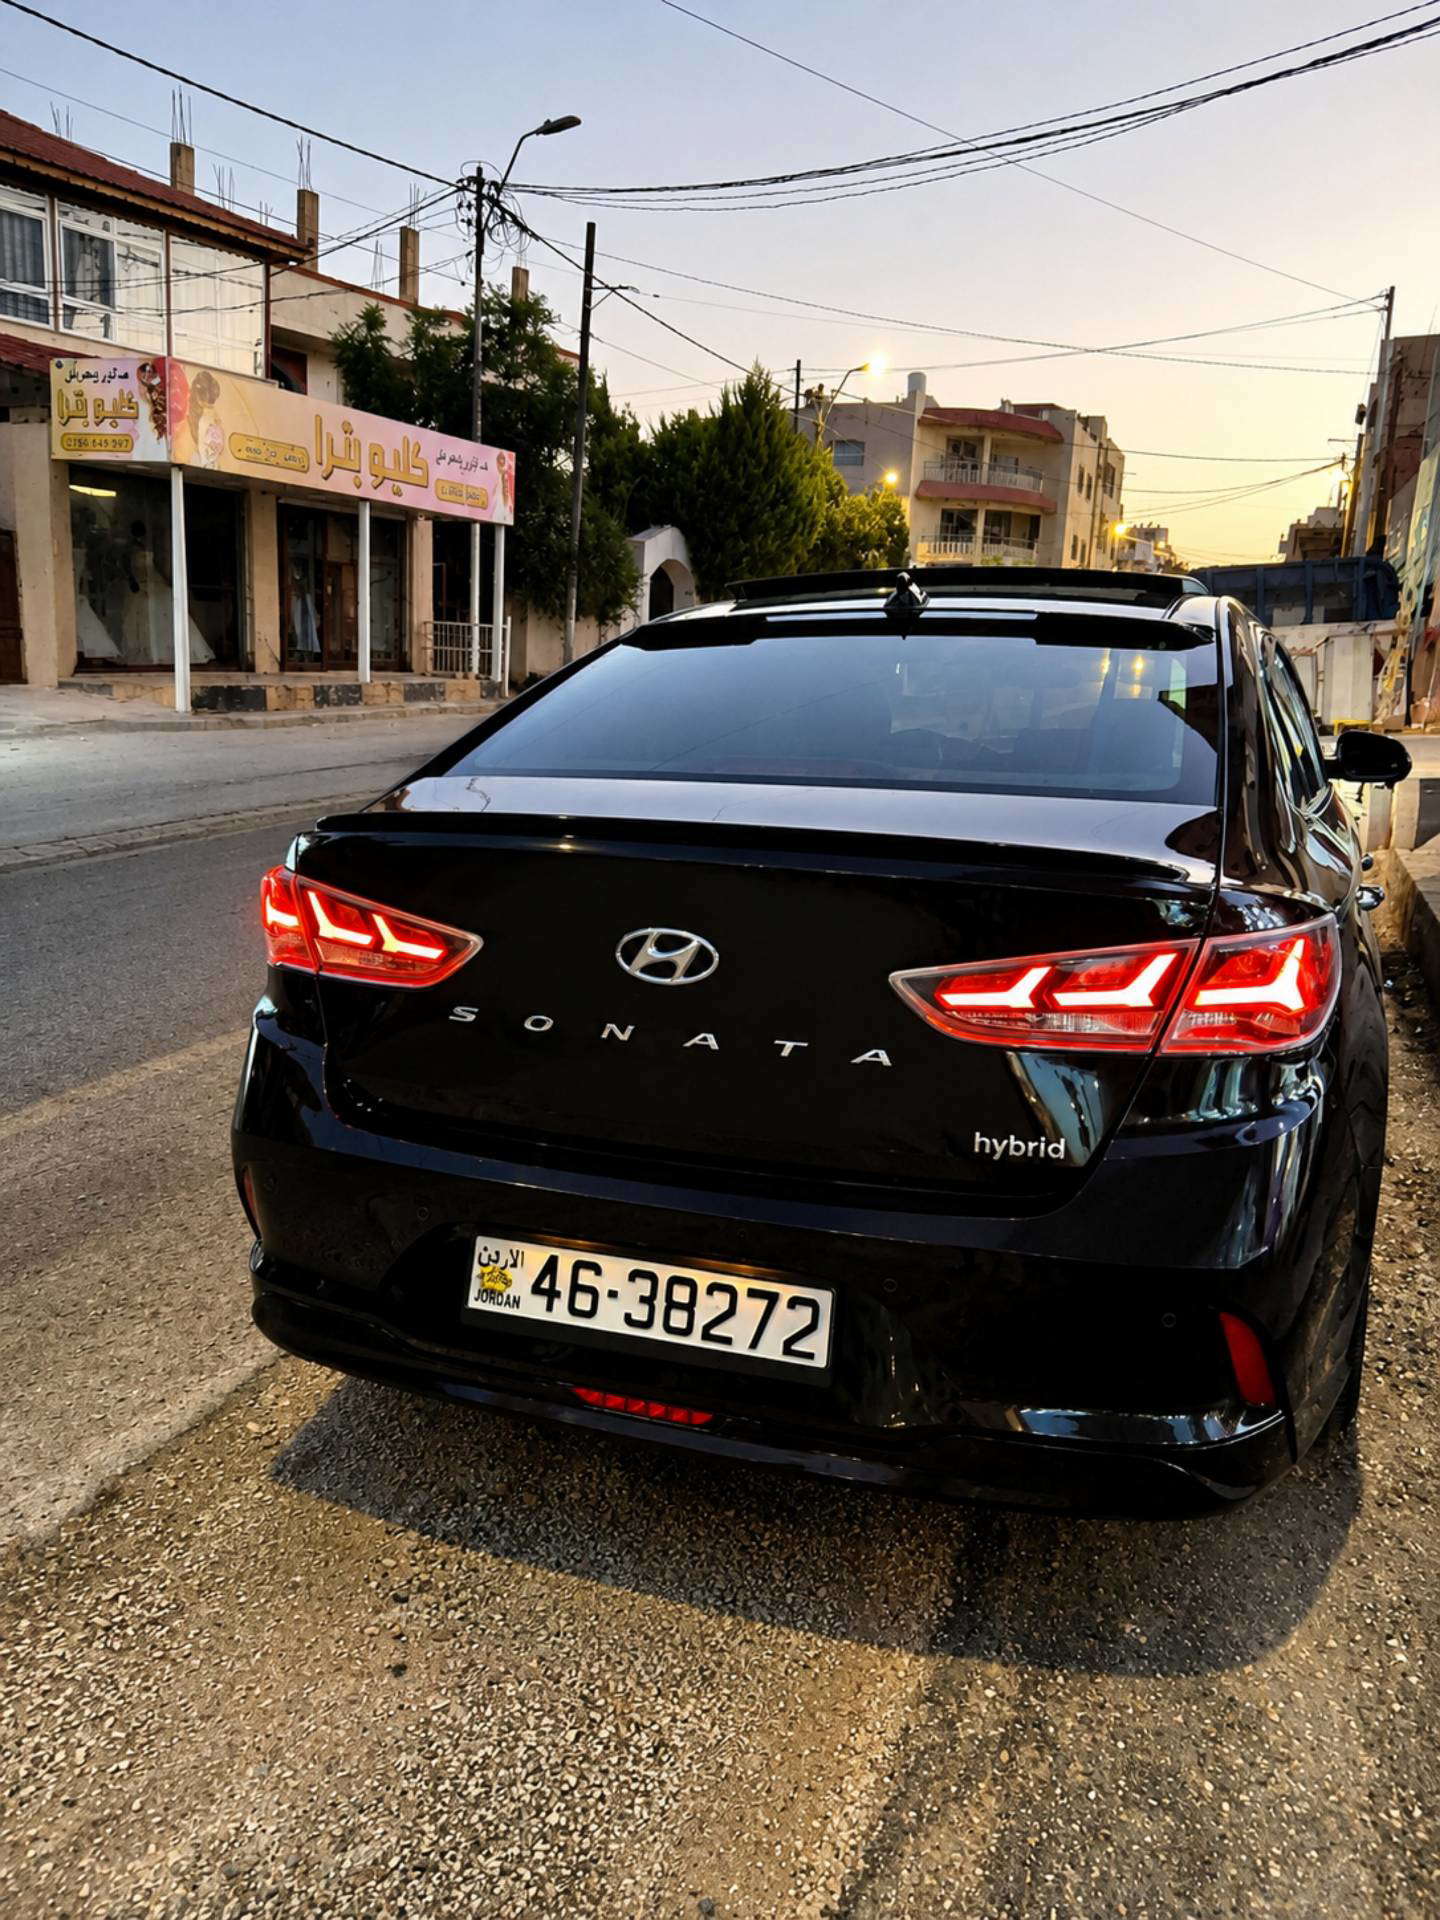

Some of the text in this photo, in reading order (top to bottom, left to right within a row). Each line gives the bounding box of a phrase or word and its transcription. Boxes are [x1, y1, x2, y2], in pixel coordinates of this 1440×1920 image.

[449, 1006, 893, 1067] SONATA
[974, 1131, 1066, 1160] hybrid
[474, 1288, 521, 1310] JORDAN
[530, 1254, 820, 1360] 46-38272
